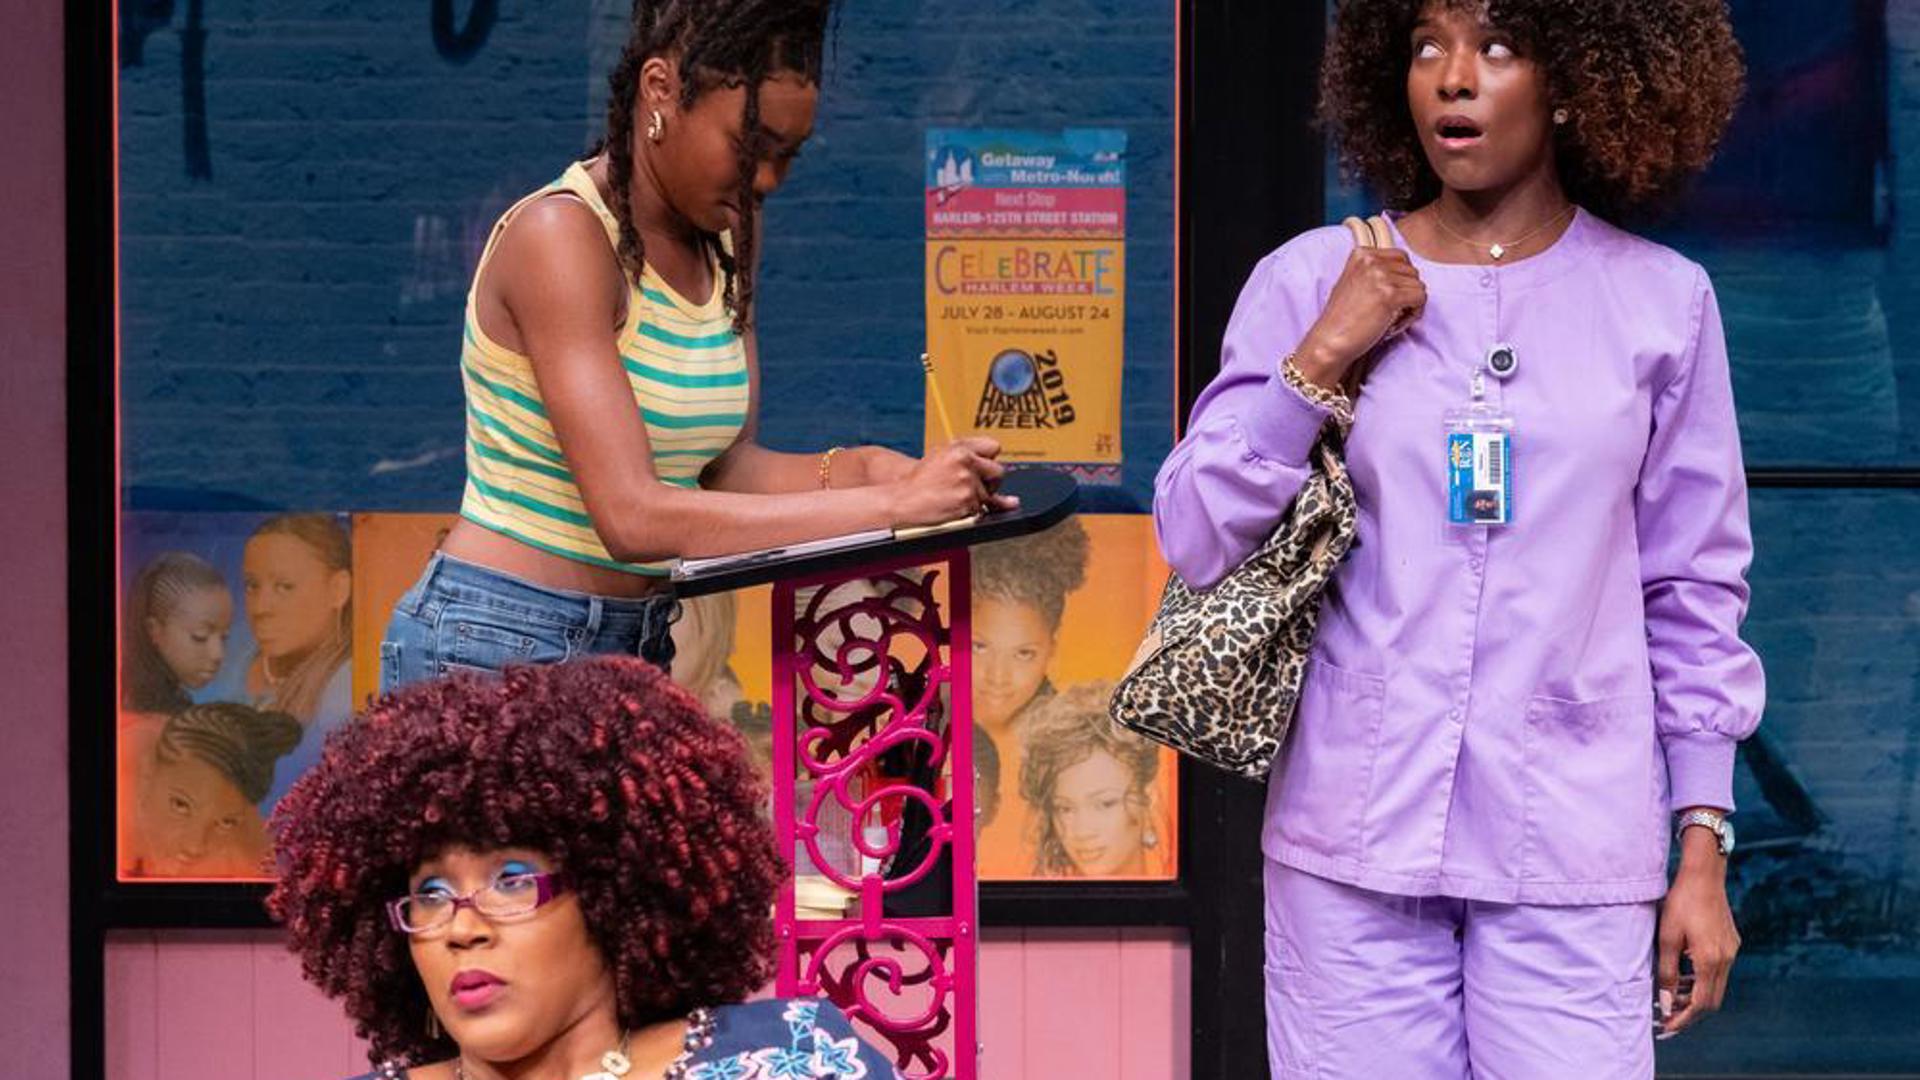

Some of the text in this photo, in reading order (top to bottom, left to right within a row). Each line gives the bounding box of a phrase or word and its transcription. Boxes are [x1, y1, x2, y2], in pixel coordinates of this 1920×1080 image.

[981, 153, 1055, 168] Getaway
[995, 192, 1056, 207] Next Stop
[933, 211, 1118, 225] HARLEM-125TH STREET STATION
[965, 283, 1089, 294] HARLEM WEEK
[941, 305, 979, 320] JULY
[983, 305, 1003, 320] 28
[1019, 305, 1084, 320] AUGUST
[1090, 306, 1110, 320] 24
[1034, 349, 1076, 427] 2019
[974, 412, 1055, 430] WEEK
